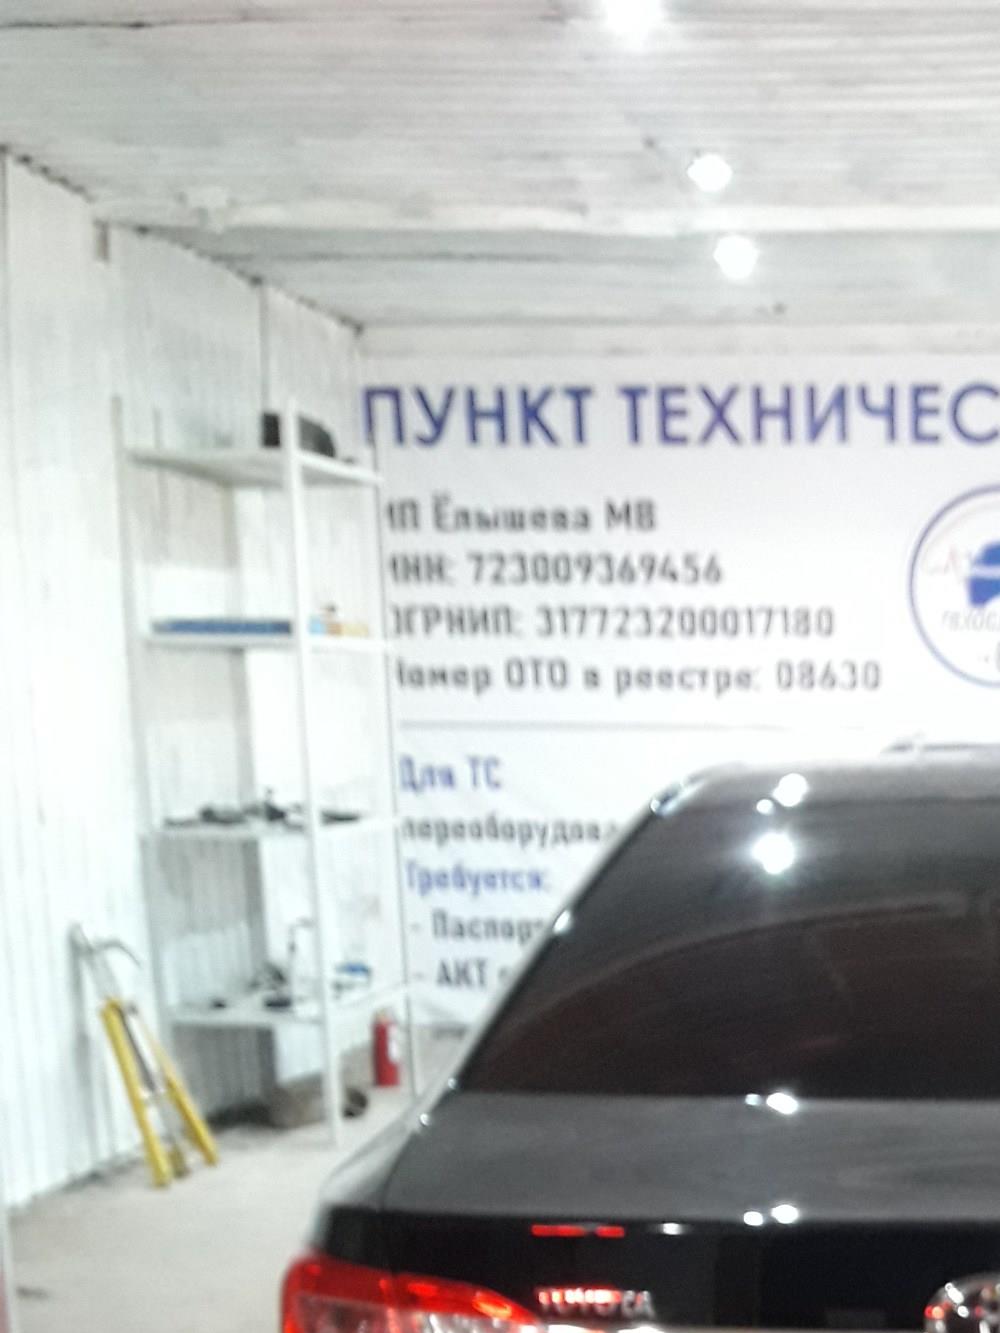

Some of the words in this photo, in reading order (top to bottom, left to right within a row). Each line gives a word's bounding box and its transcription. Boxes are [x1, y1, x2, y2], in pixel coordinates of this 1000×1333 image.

[360, 384, 595, 449] ПУНКТ
[605, 498, 657, 532] МВ
[466, 551, 724, 586] 723009369456
[535, 605, 836, 639] 317723200017180
[506, 657, 569, 691] ОТО
[776, 660, 882, 693] 08630
[466, 755, 503, 790] ТС
[436, 957, 489, 989] АКТ
